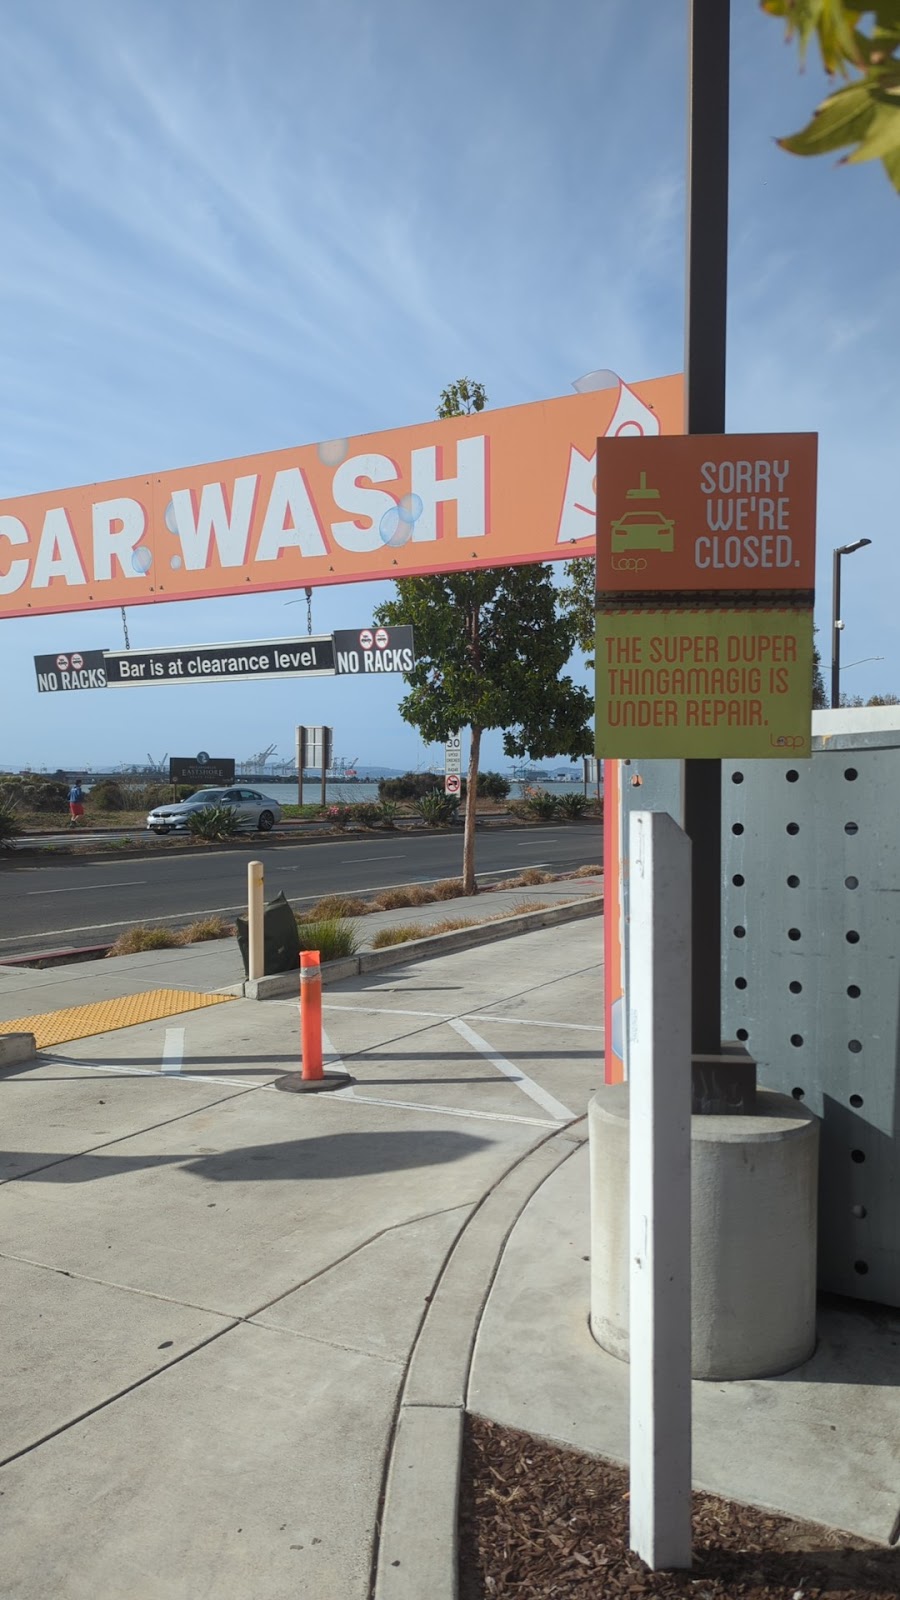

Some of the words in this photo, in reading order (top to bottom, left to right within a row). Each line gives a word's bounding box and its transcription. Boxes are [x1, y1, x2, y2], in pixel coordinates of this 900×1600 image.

[700, 460, 790, 494] SORRY
[0, 498, 148, 595] CAR
[171, 434, 491, 571] WASH
[706, 496, 790, 531] WE'RE
[694, 535, 800, 568] CLOSED.
[119, 661, 145, 677] Bar
[149, 659, 164, 676] is
[168, 658, 183, 675] at
[187, 656, 270, 674] clearance
[274, 647, 317, 668] level
[336, 651, 359, 673] NO
[363, 648, 413, 672] RACKS
[605, 637, 641, 664] THE
[649, 636, 718, 663] SUPER
[727, 635, 797, 662] DUPER
[38, 672, 58, 691] NO
[61, 668, 107, 690] RACKS
[608, 668, 762, 695] THINGAMAGIG
[769, 667, 789, 694] IS
[607, 700, 678, 727] UNDER
[686, 700, 769, 726] REPAIR.
[447, 739, 460, 747] 30
